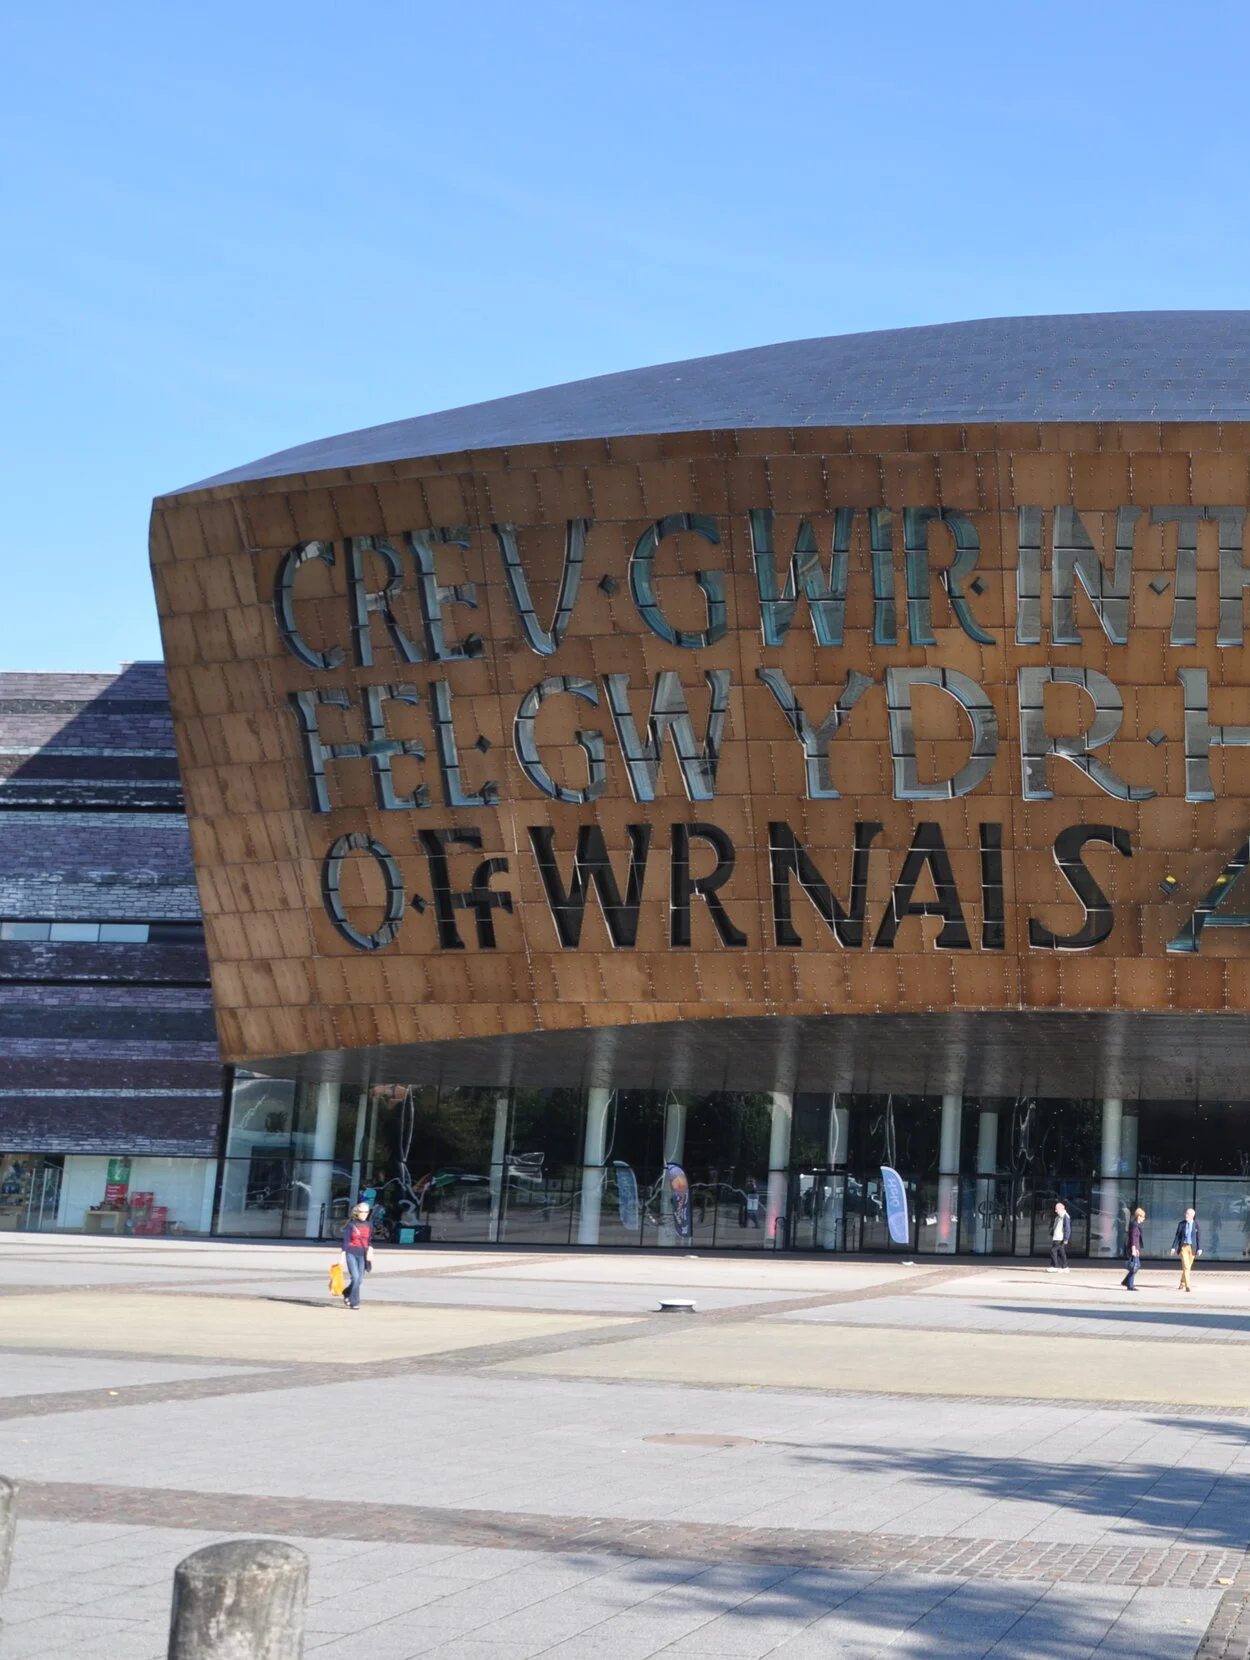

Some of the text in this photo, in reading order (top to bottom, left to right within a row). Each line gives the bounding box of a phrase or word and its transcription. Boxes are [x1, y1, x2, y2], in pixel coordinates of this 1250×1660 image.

[629, 506, 996, 648] GWIR
[1014, 505, 1142, 646] IN
[294, 680, 500, 813] FEL
[512, 666, 1157, 804] GWYDR
[321, 831, 405, 951] O
